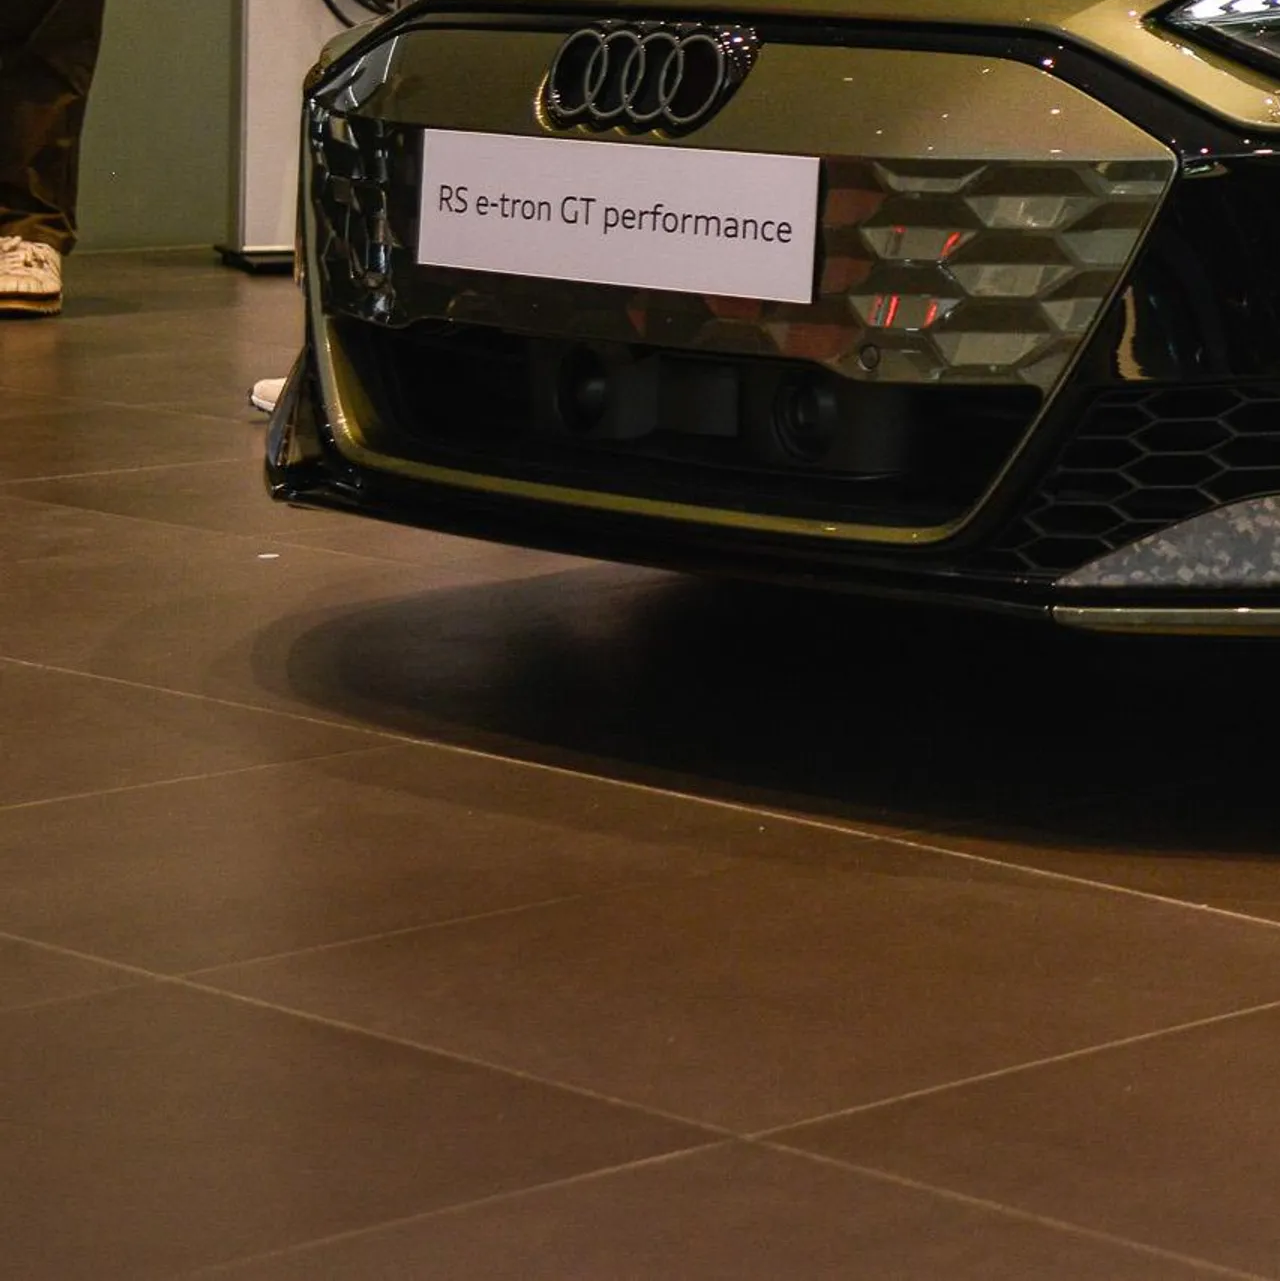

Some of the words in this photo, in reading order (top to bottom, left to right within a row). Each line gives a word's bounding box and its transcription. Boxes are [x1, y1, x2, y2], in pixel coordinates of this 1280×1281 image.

[438, 185, 469, 214] RS
[475, 192, 552, 222] e-tron
[560, 196, 597, 226] GT
[603, 204, 794, 244] performance
